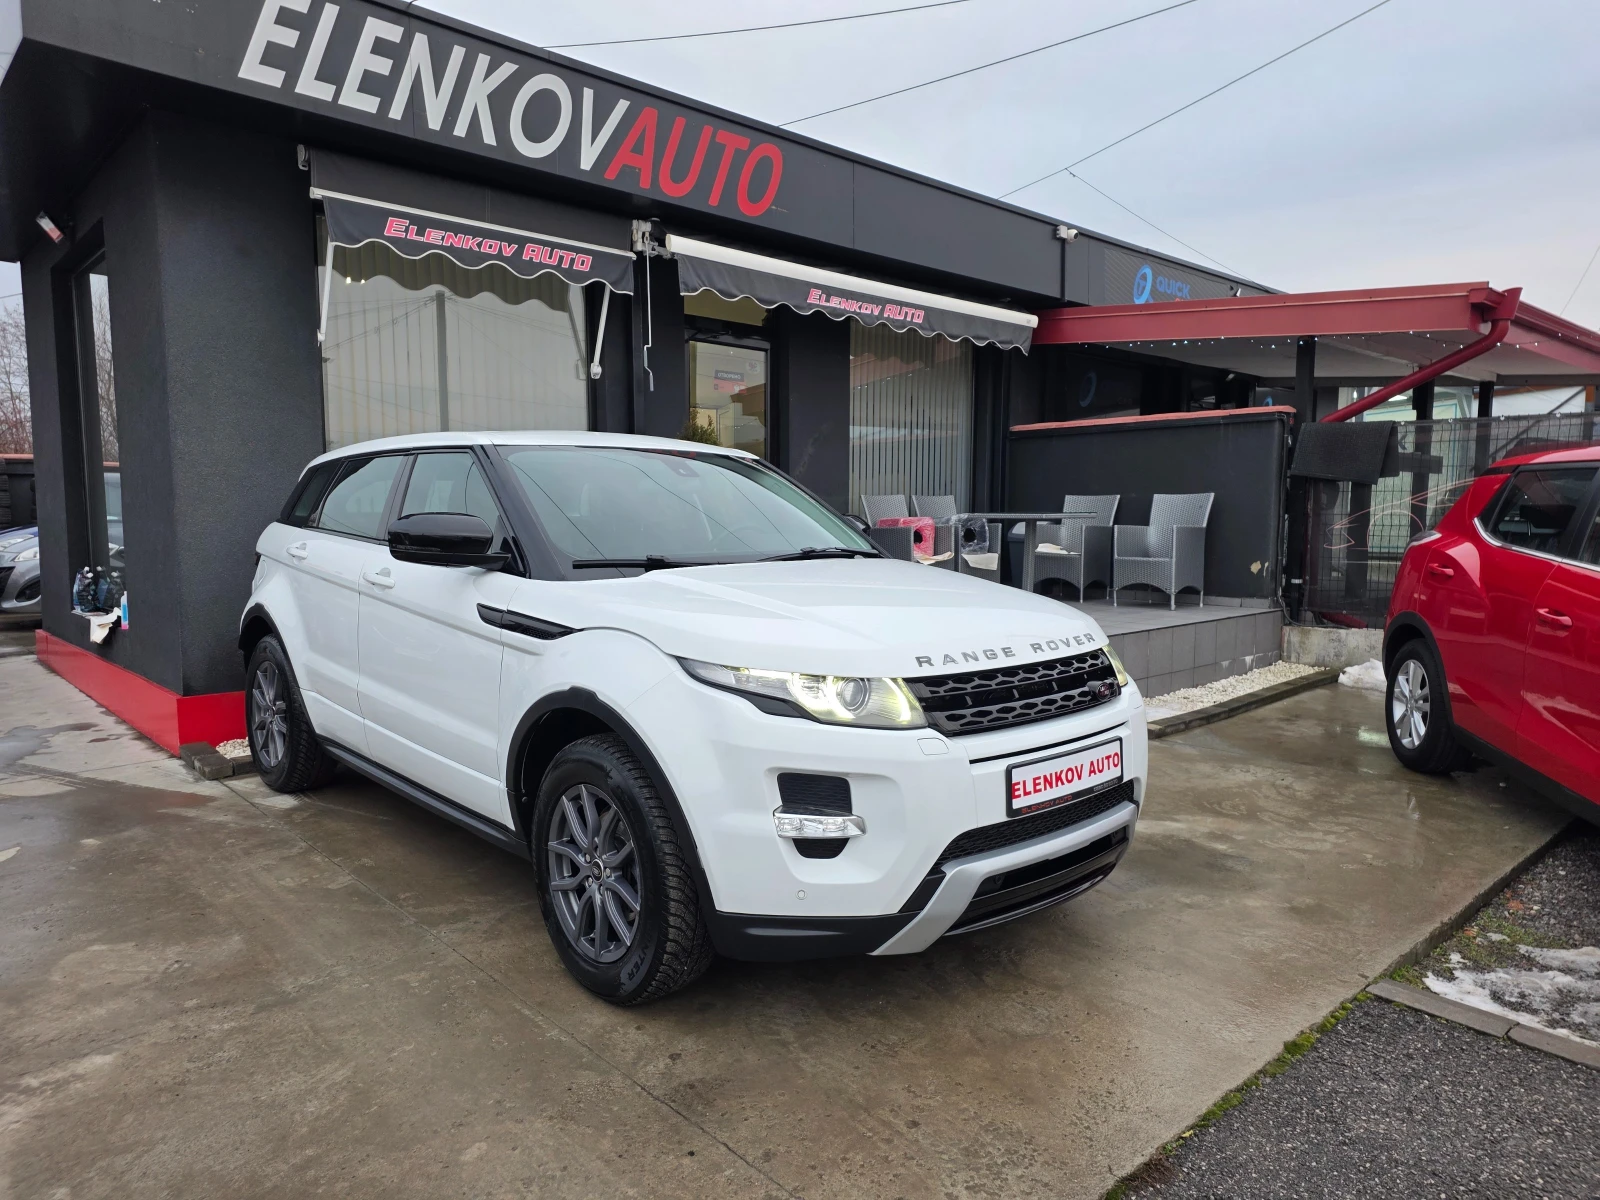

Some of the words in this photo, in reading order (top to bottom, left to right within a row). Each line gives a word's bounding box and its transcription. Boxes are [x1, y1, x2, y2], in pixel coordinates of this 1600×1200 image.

[237, 0, 630, 171] ELENKOV
[603, 107, 784, 217] AUTO
[384, 217, 518, 256] ELENKOV
[522, 243, 593, 271] AUTO
[1156, 275, 1191, 299] QUICK
[883, 303, 925, 323] AUTO
[914, 646, 1016, 668] RANGE
[1029, 632, 1096, 654] ROVER
[1011, 763, 1084, 800] ELENKOV
[1088, 752, 1120, 777] AUTO
